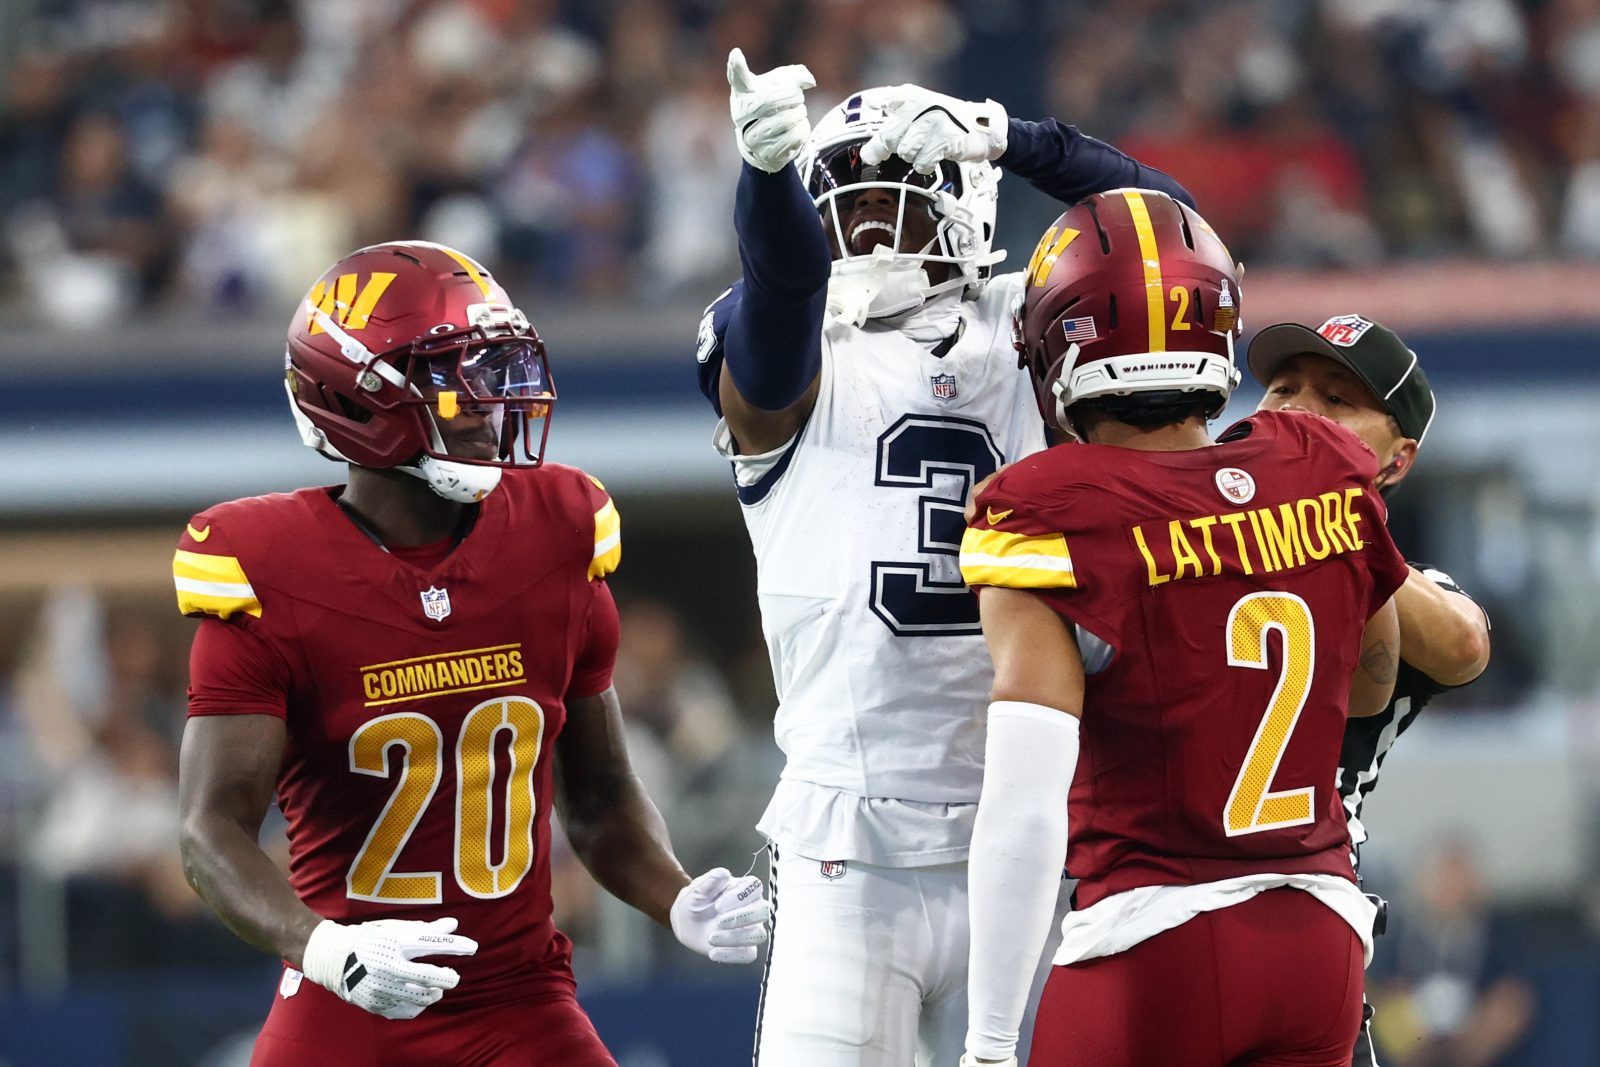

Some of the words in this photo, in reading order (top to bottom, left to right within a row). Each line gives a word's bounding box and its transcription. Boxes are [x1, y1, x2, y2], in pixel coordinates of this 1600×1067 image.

[1169, 286, 1191, 331] 2
[1320, 323, 1355, 344] NFL
[1122, 362, 1196, 373] WASHINGTON
[934, 384, 955, 397] NFL
[868, 412, 1006, 637] 3
[1131, 487, 1364, 586] LATTIMORE
[428, 600, 447, 615] NFL
[363, 650, 525, 700] COMMANDERS
[1222, 591, 1315, 838] 2
[345, 695, 545, 905] 20
[823, 861, 842, 875] NFL
[737, 879, 762, 902] DIZERO
[417, 935, 455, 944] ADIZERO
